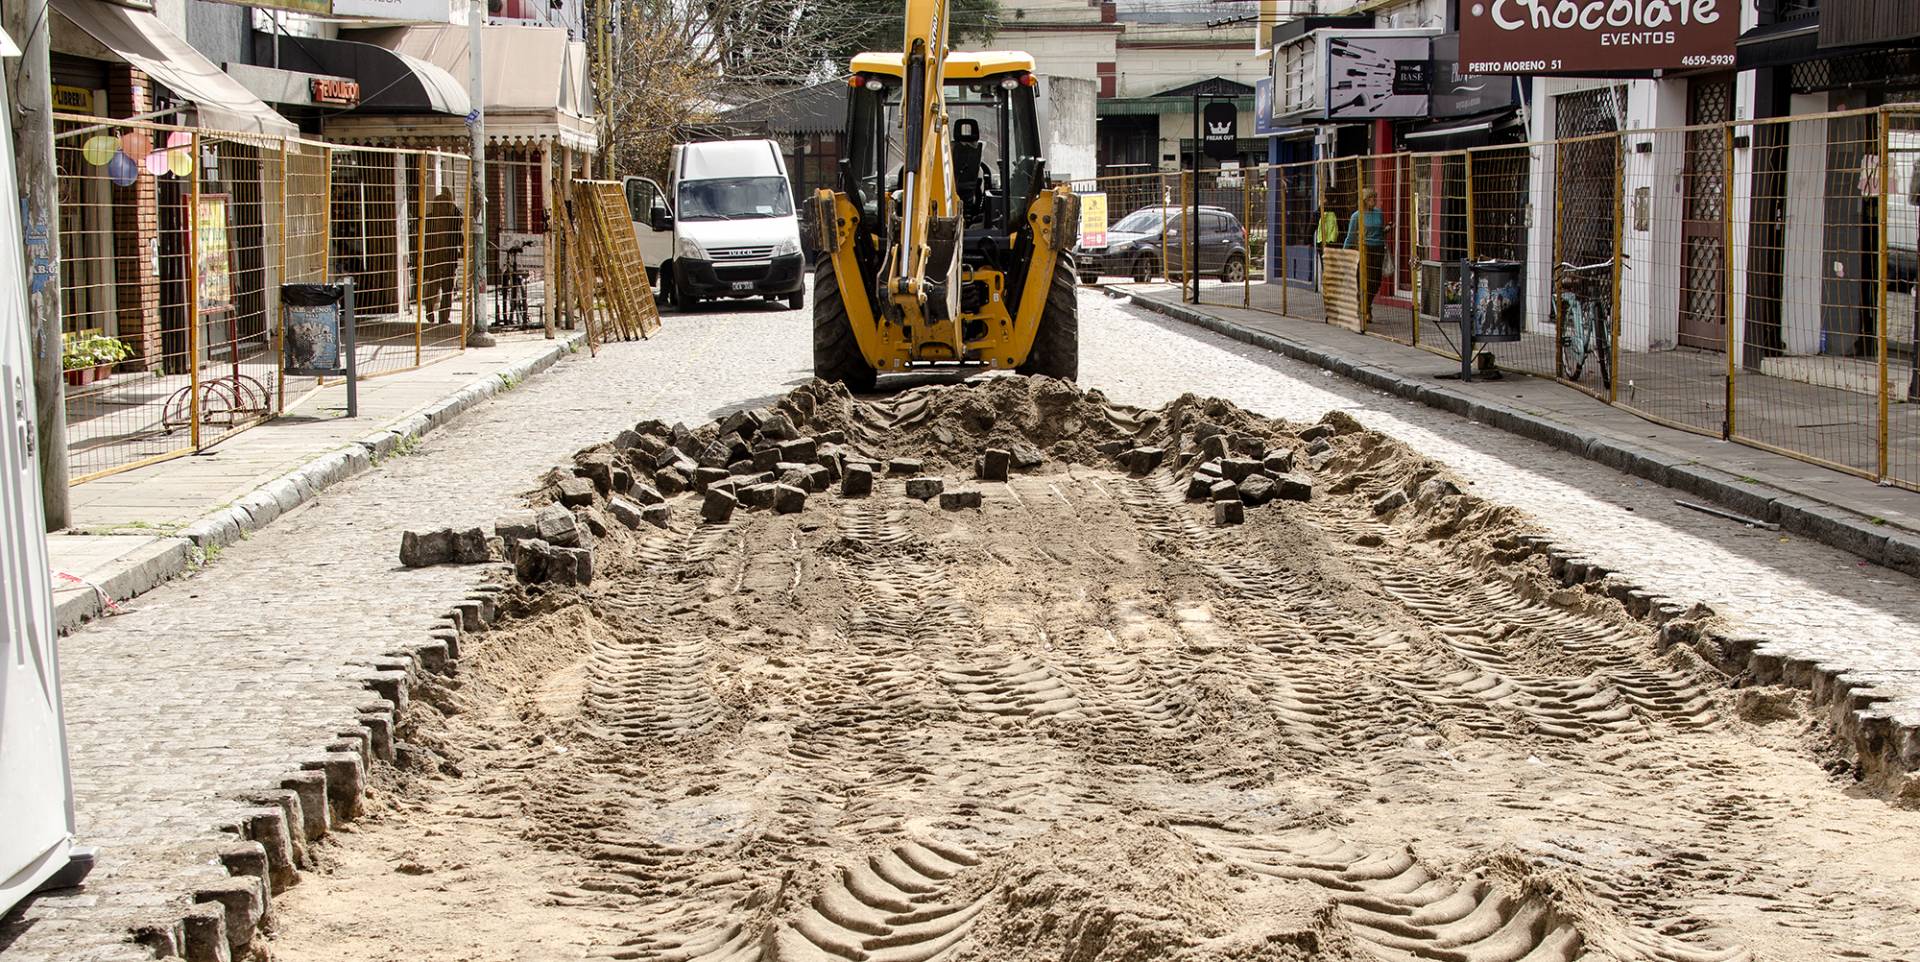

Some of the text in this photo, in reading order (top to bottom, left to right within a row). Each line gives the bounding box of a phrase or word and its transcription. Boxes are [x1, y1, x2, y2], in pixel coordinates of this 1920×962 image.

[1491, 0, 1719, 30] Chocolate
[1601, 31, 1675, 46] EVENTOS
[1469, 59, 1562, 73] PERITO MORENO 51
[1681, 54, 1735, 66] 4659-5939
[1400, 73, 1424, 81] BASE
